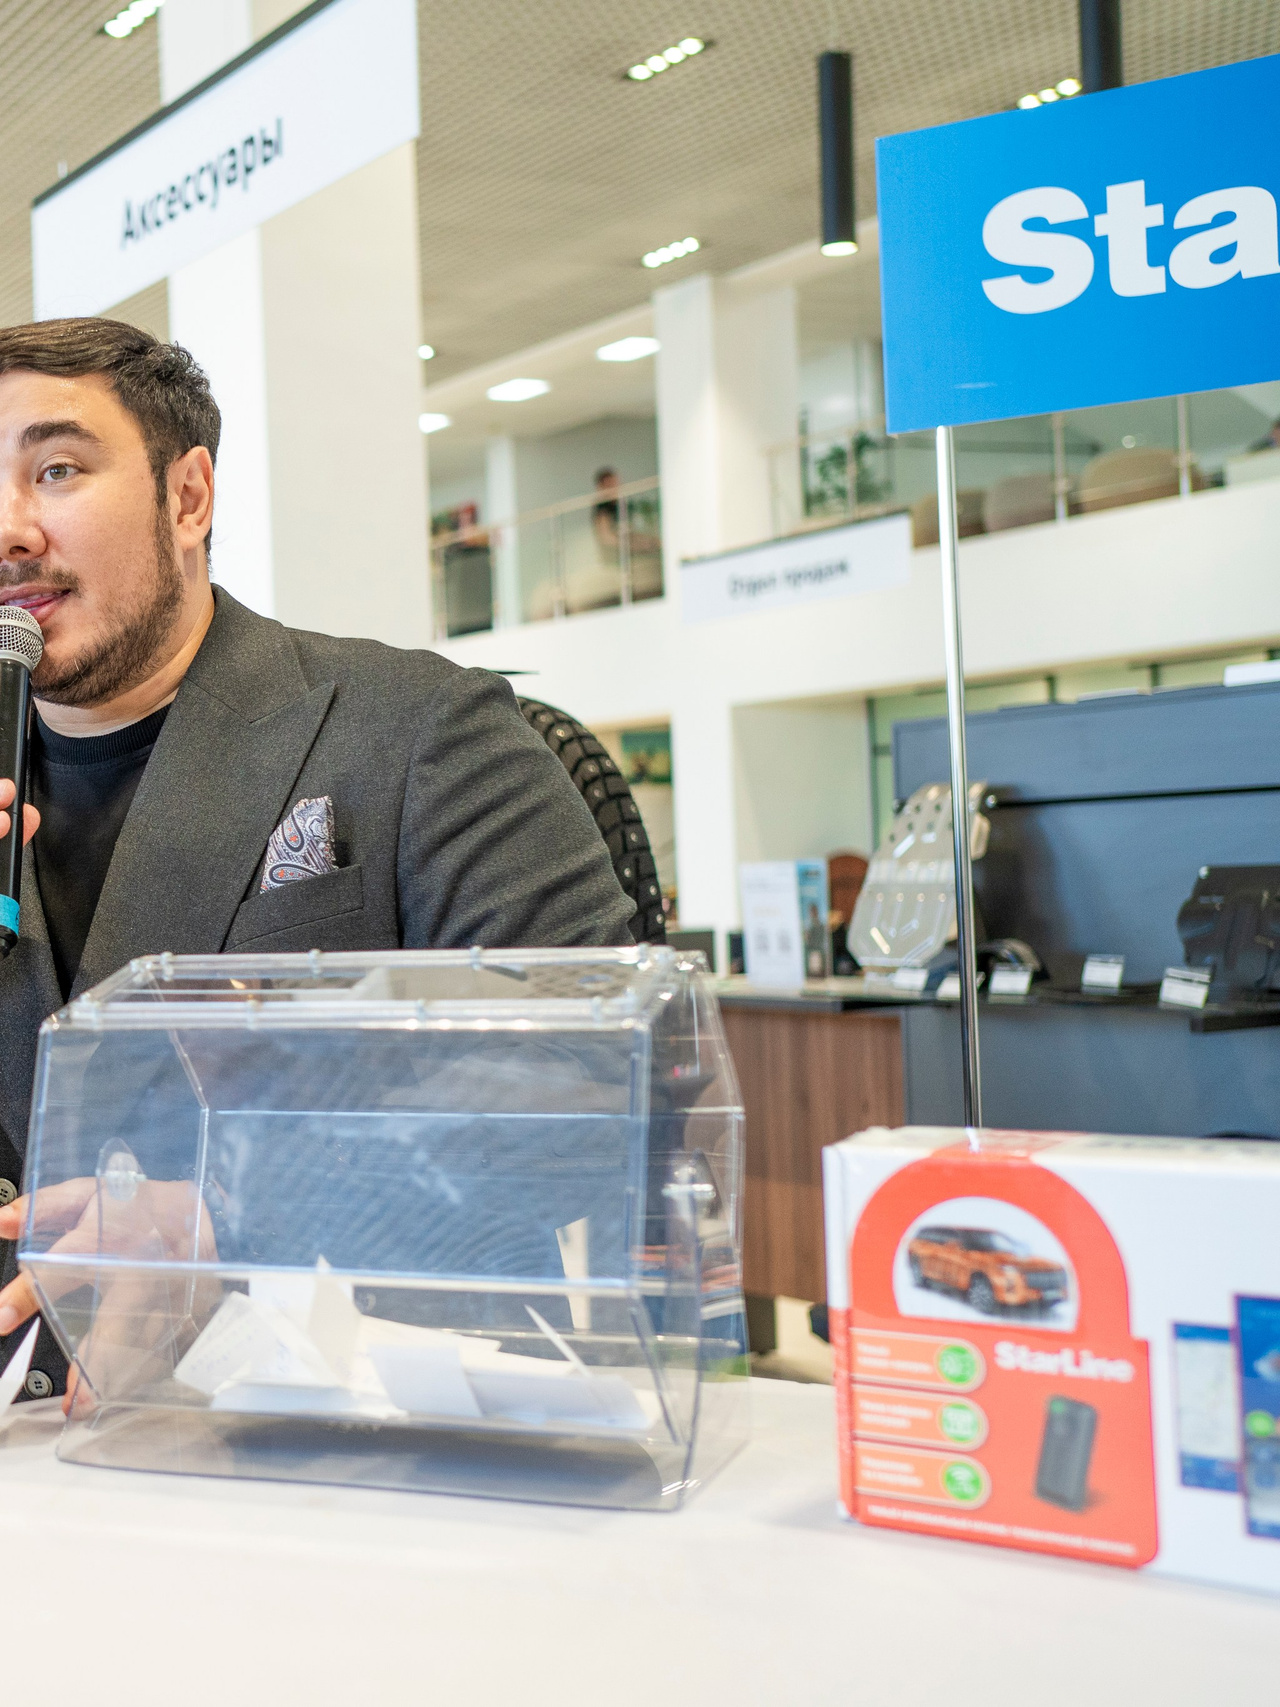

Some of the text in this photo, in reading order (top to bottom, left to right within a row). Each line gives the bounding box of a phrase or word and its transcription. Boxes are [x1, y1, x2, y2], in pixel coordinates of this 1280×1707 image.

[120, 116, 282, 250] Аксессуары
[981, 179, 1280, 315] Sta
[994, 1341, 1135, 1383] StarLine
